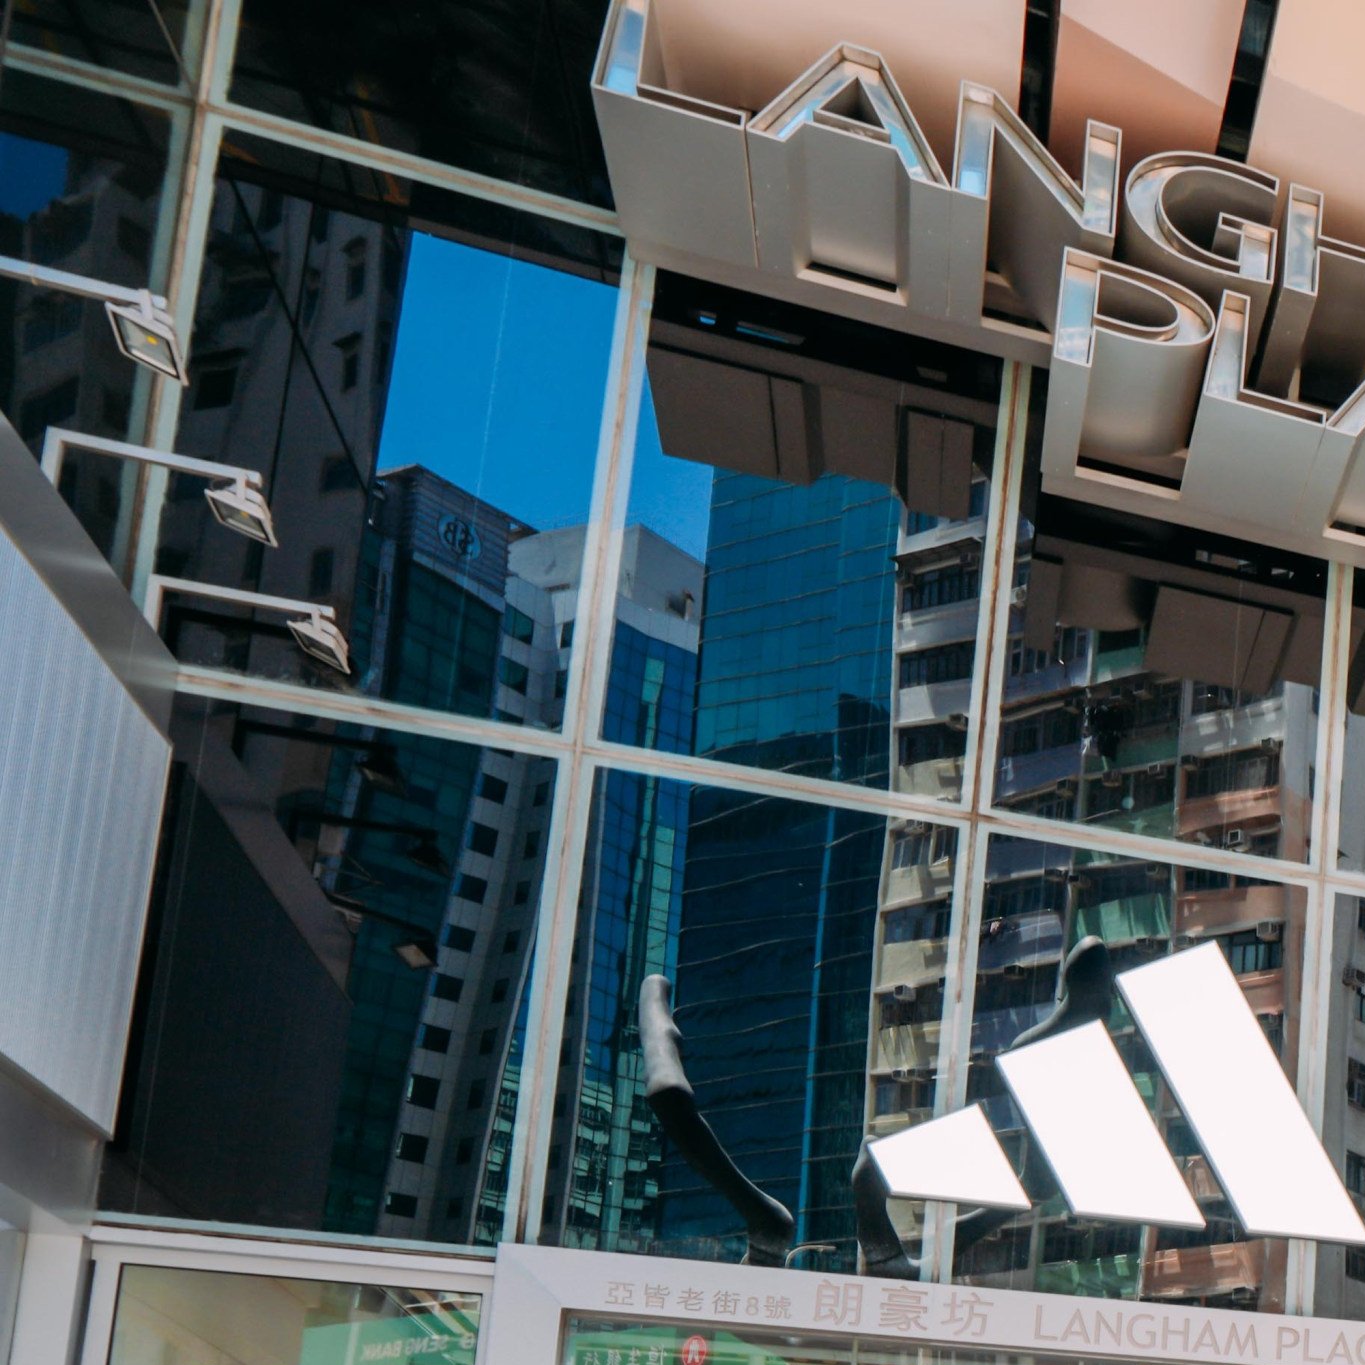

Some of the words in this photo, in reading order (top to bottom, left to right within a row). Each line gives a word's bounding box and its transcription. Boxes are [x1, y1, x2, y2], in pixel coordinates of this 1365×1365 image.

[813, 1278, 996, 1337] 朗豪坊
[1033, 1303, 1260, 1360] LANGHAM
